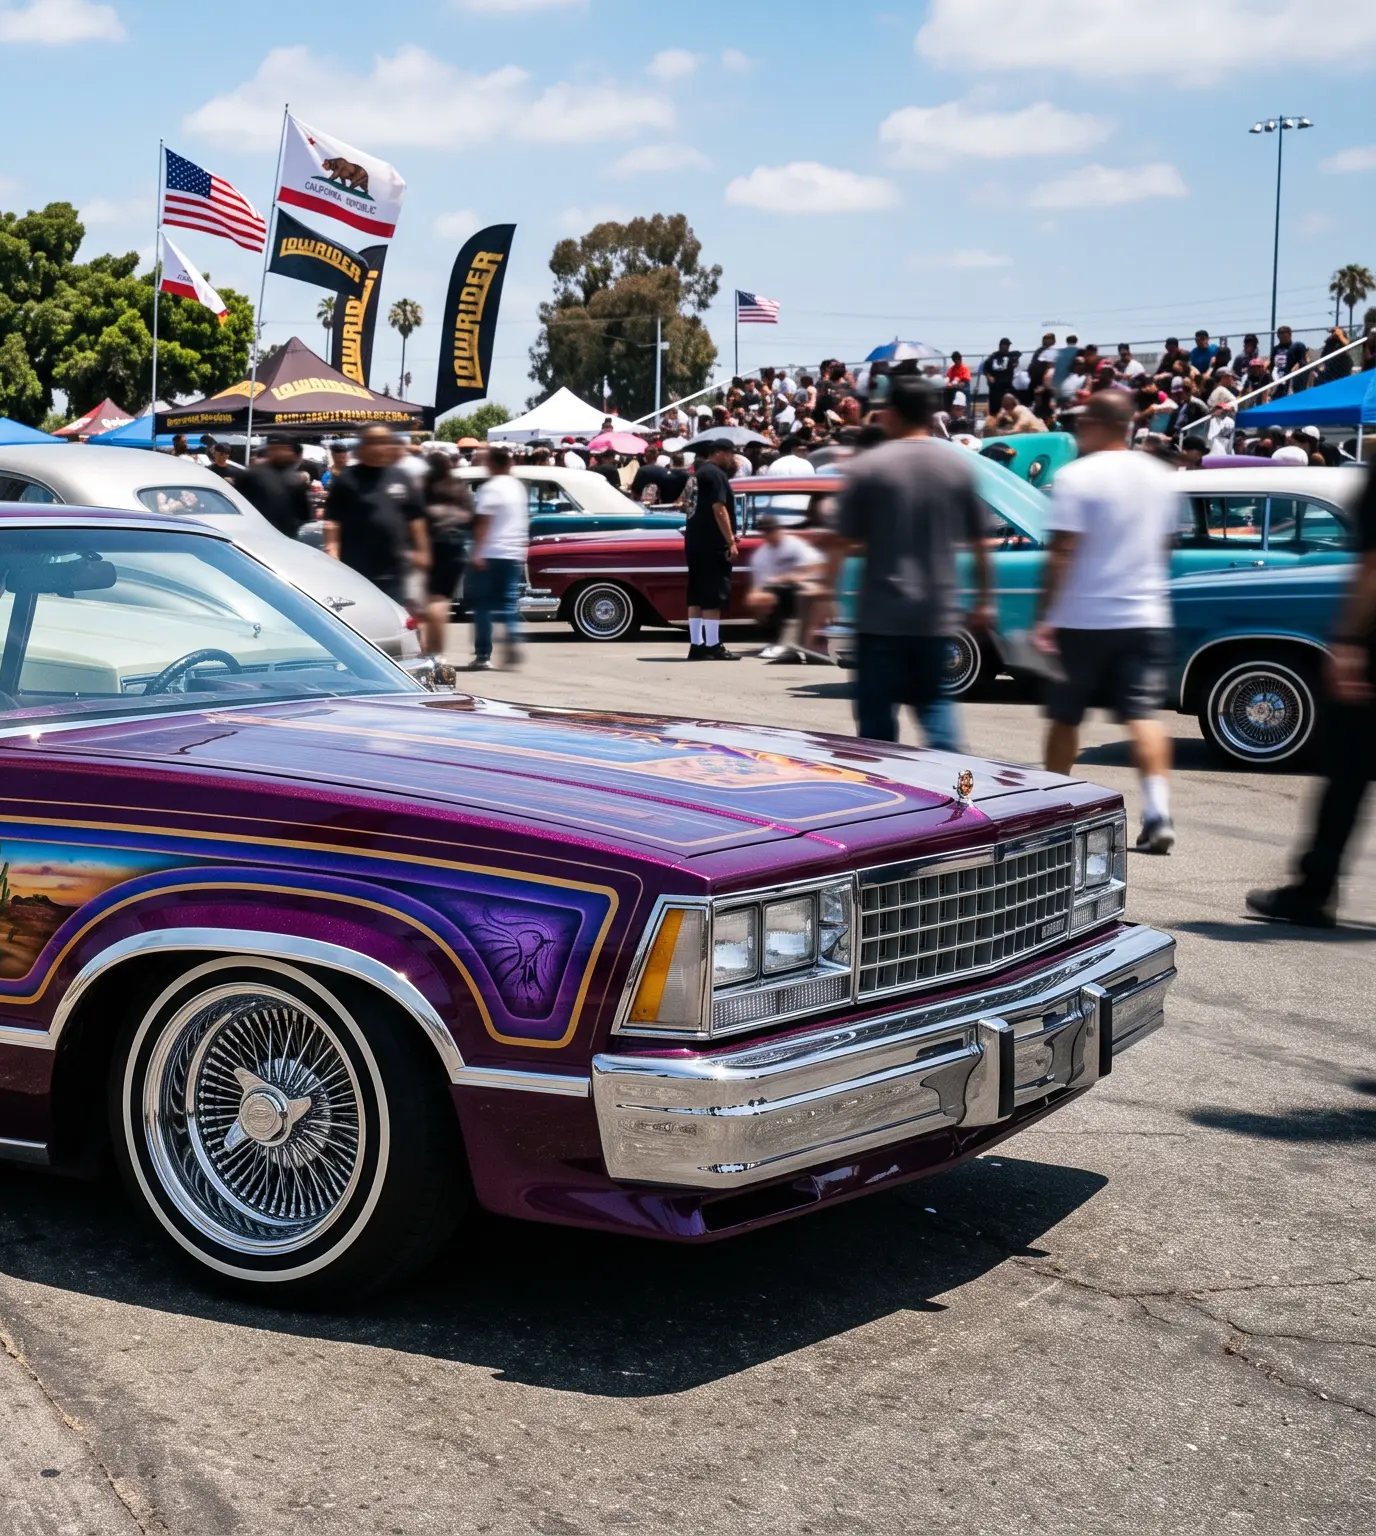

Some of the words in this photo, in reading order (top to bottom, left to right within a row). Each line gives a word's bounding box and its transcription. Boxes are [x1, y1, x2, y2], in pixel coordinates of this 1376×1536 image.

[279, 237, 361, 284] LOWRIDER
[453, 250, 504, 389] LOWRIDER
[341, 269, 379, 387] OWRID
